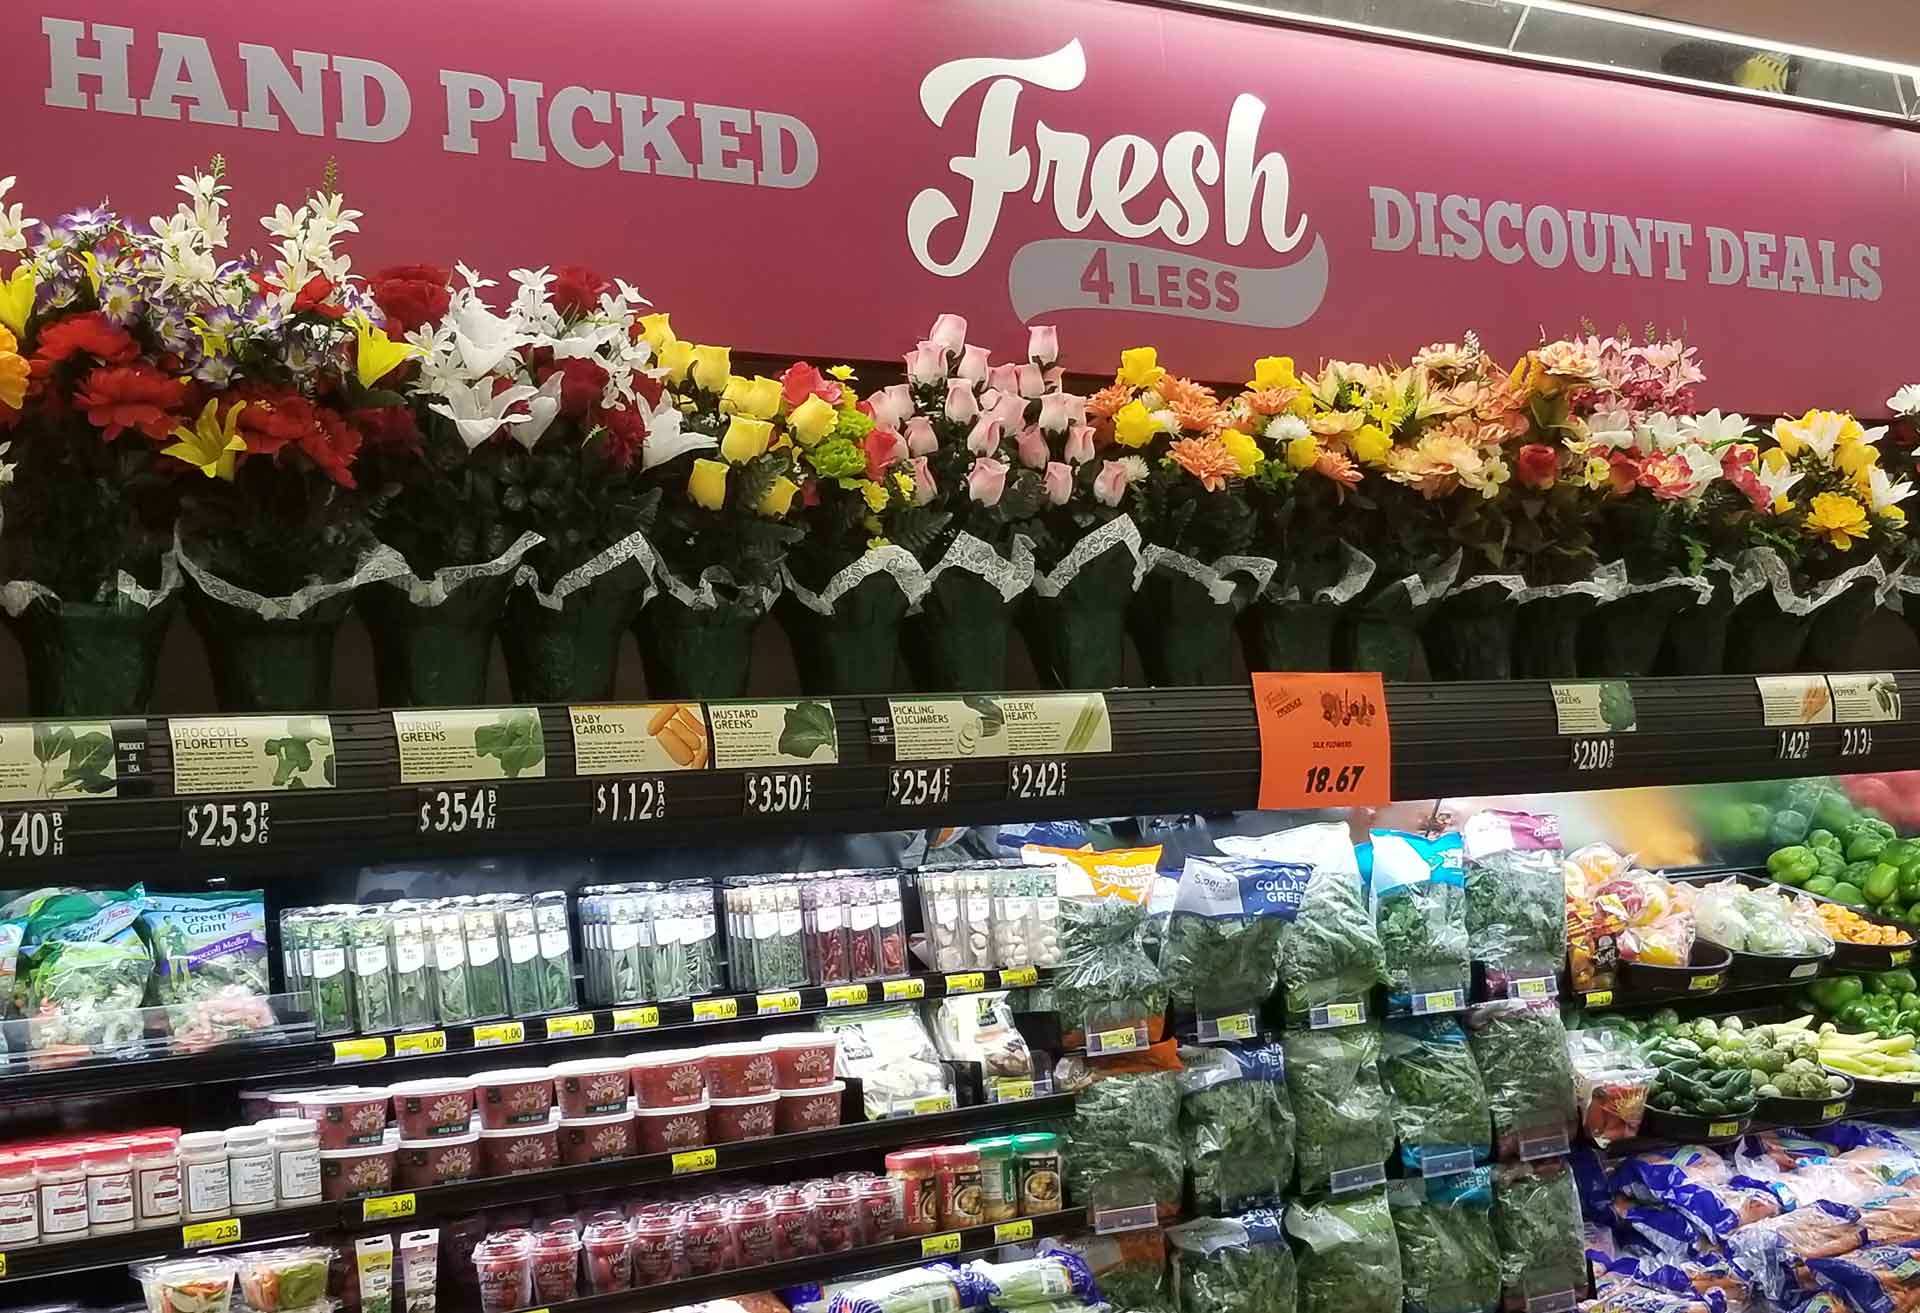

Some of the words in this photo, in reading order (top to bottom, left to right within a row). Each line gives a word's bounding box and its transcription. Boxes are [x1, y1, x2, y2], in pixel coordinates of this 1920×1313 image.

[41, 16, 411, 143] HAND
[439, 69, 819, 190] PICKED
[907, 37, 1308, 277] Fresh
[1369, 185, 1693, 282] DISCOUNT
[1706, 226, 1882, 302] DEALS
[1078, 245, 1116, 306] 4
[1128, 250, 1240, 313] LESS
[893, 705, 934, 715] PICKLING
[1003, 702, 1034, 711] CELERY
[573, 714, 601, 724] BABY
[712, 710, 758, 720] MUSTARD
[895, 714, 949, 725] CUCUMBERS
[1005, 711, 1038, 720] HEARTS
[400, 721, 441, 731] TURNIP
[575, 724, 625, 735] CARROTS
[714, 720, 752, 730] GREENS
[174, 727, 238, 738] BROCCOLI
[401, 731, 446, 742] GREENS
[175, 738, 249, 750] FLORETTES
[1011, 762, 1059, 798] $2.42
[1305, 766, 1365, 793] 18.67
[892, 768, 941, 805] $2.54
[748, 774, 802, 812] $3.50
[597, 781, 653, 822] $1.12
[420, 789, 485, 832] $3.54
[187, 801, 257, 846] $2.53
[182, 911, 226, 922] Green
[187, 921, 226, 935] Giant
[222, 935, 250, 955] Medley
[968, 978, 984, 989] 1.00
[1022, 972, 1037, 984] 1.00
[907, 983, 922, 994] 1.00
[850, 989, 867, 1001] 1.00
[783, 996, 799, 1008] 1.00
[719, 1003, 737, 1015] 1.00
[640, 1012, 658, 1024] 1.00
[575, 1019, 594, 1031] 1.00
[503, 1028, 523, 1040] 1.00
[424, 1036, 444, 1049] 1.00
[697, 1154, 715, 1166] 3.80
[392, 1200, 412, 1212] 3.80
[215, 1225, 239, 1240] 2.39
[944, 1238, 960, 1249] 4.73
